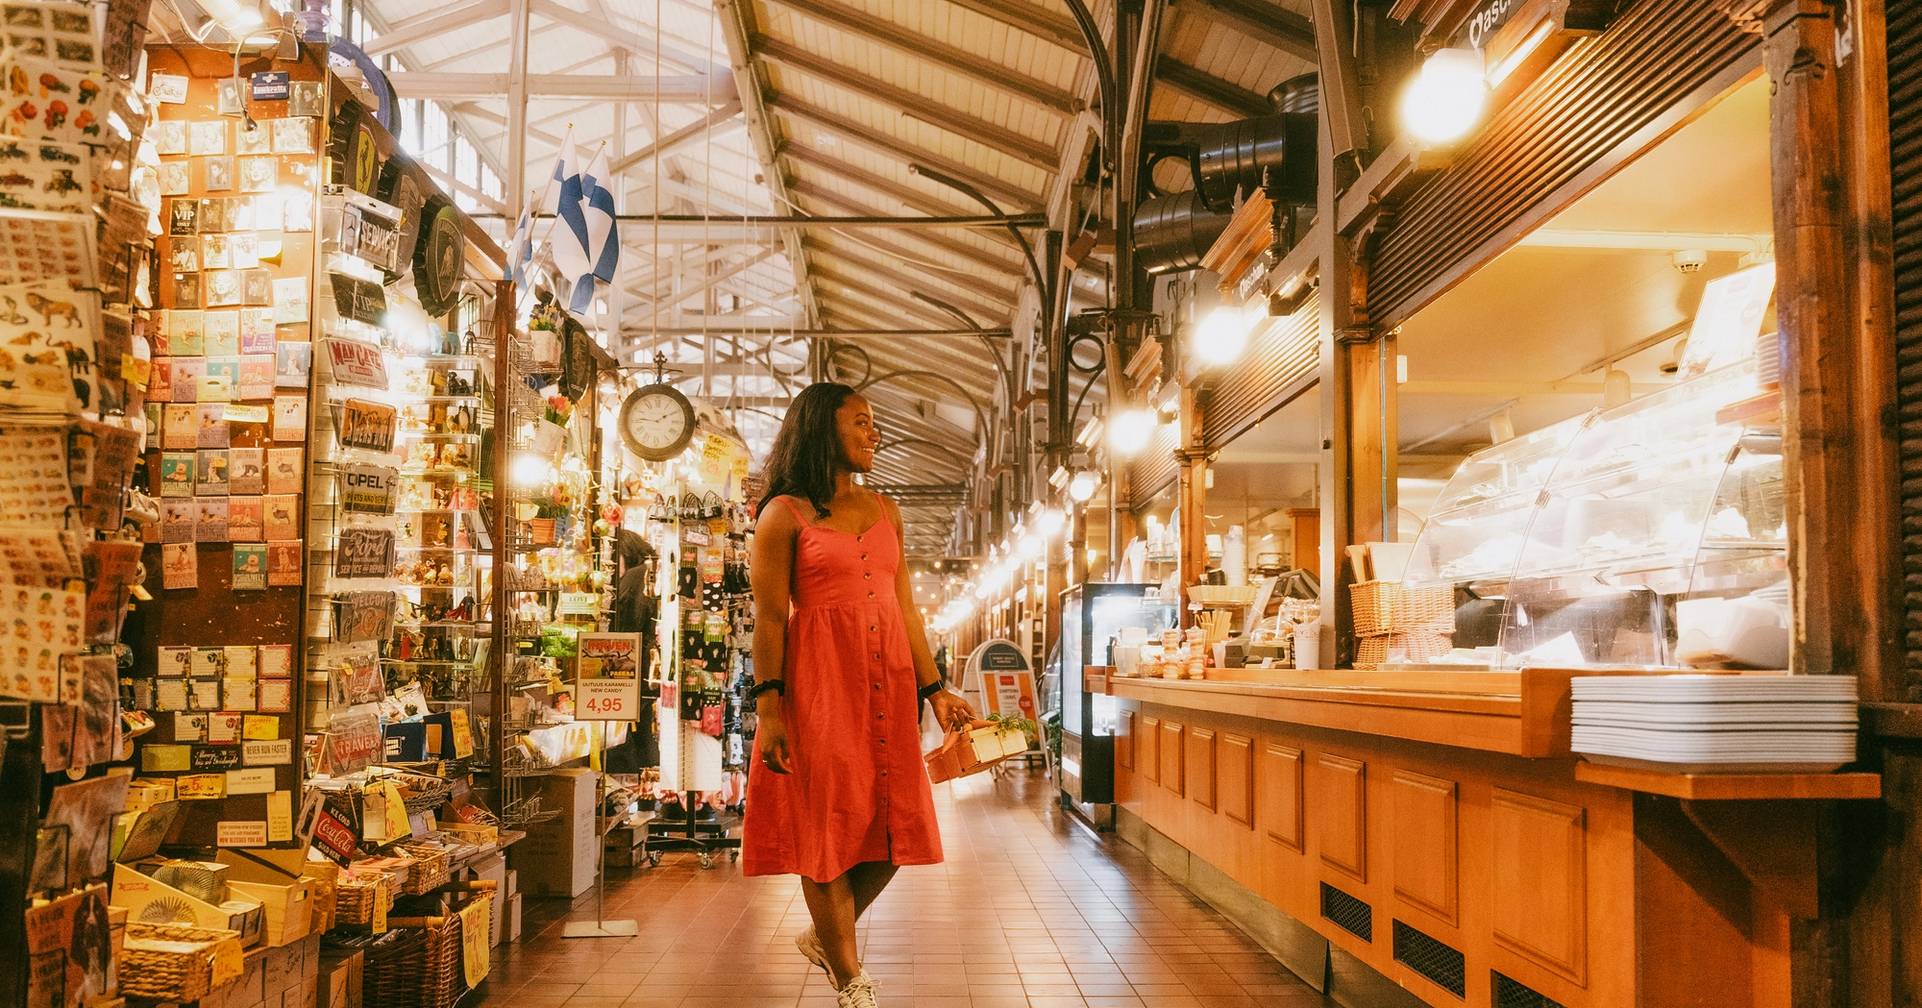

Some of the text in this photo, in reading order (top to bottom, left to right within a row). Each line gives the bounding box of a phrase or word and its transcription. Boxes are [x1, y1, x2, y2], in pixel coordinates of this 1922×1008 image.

[174, 210, 195, 220] VIP
[331, 341, 383, 370] MAN CAVE
[347, 473, 384, 489] OPEL
[349, 531, 388, 557] Ford
[586, 697, 622, 714] 4,95
[271, 744, 287, 753] FASTER
[338, 813, 351, 827] COLD
